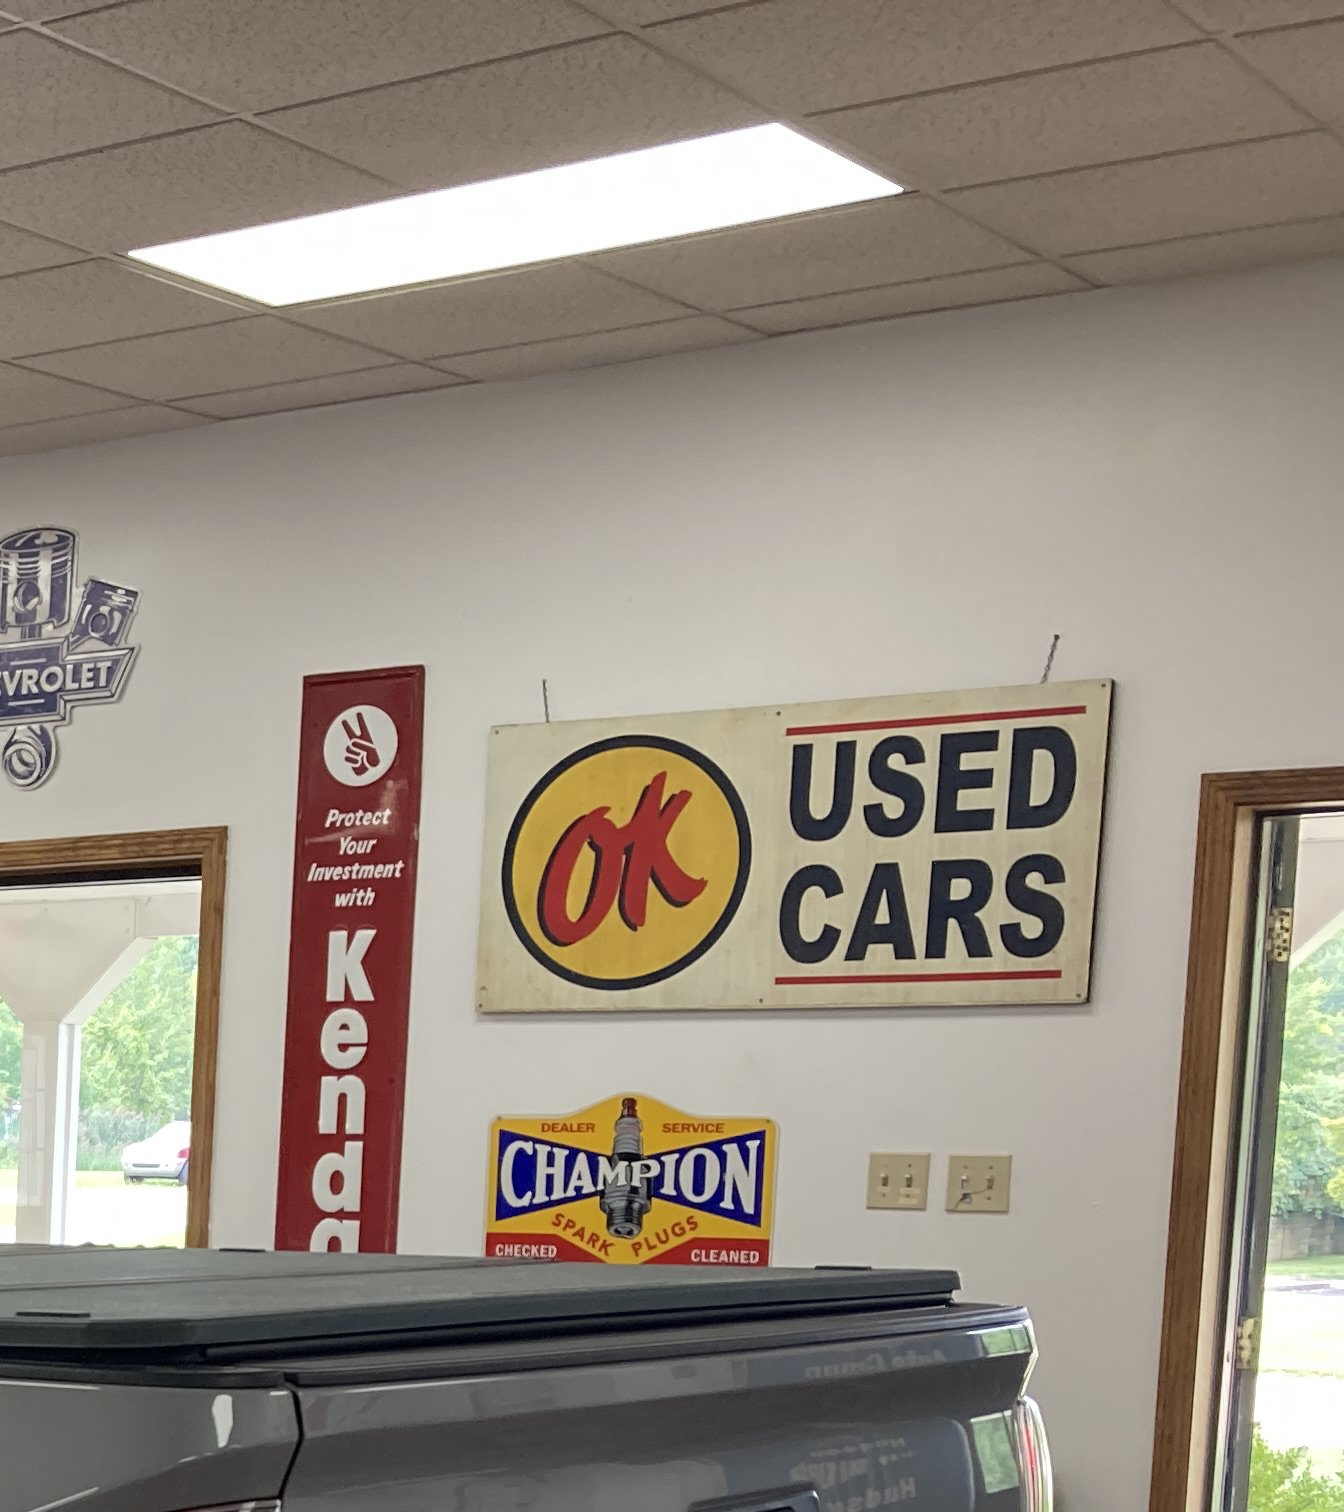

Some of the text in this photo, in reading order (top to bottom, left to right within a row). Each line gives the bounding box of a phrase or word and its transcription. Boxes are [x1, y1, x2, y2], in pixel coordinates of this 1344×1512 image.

[789, 726, 1077, 842] USED
[324, 807, 392, 829] Protect
[338, 836, 378, 855] Your
[537, 770, 709, 947] OK
[307, 859, 405, 882] Investment
[334, 887, 376, 908] with
[778, 853, 1066, 964] CARS
[541, 1122, 725, 1134] DEALER SERVICE
[500, 1140, 761, 1215] CHAMPION
[551, 1212, 699, 1257] SPARK PLUGS
[495, 1243, 759, 1264] CHECKED CLEANED
